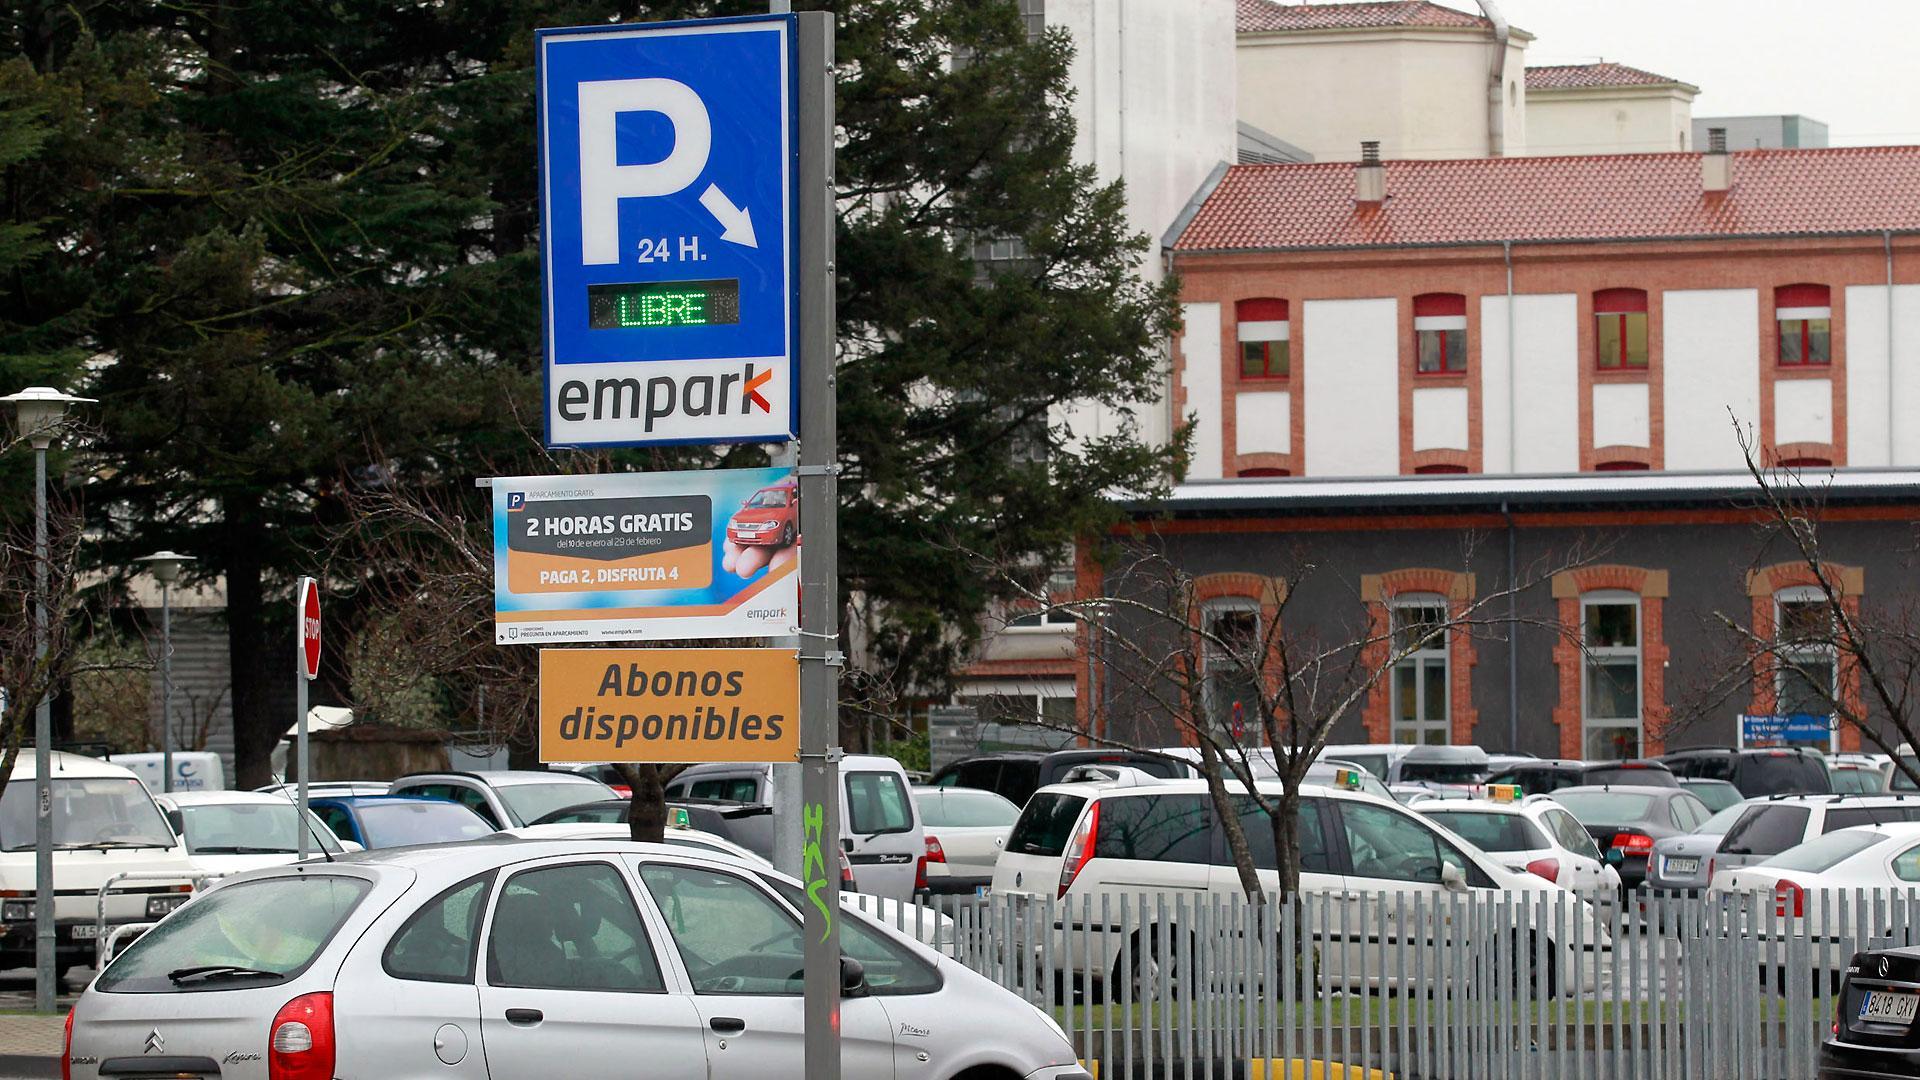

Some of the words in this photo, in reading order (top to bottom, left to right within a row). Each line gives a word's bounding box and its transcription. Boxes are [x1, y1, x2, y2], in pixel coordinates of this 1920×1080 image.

[578, 77, 712, 266] P
[638, 238, 670, 264] 24
[679, 236, 707, 261] H.
[620, 293, 706, 327] LIBRE
[557, 363, 772, 432] empark
[511, 494, 521, 507] P
[528, 489, 573, 499] APARCAMIENTO
[574, 489, 595, 497] GRATIS
[526, 518, 539, 537] 2
[544, 515, 615, 536] HORAS
[620, 512, 693, 534] GRATIS
[557, 540, 568, 549] del
[568, 540, 575, 548] 10
[575, 539, 585, 548] de
[607, 538, 614, 546] al
[614, 538, 625, 547] 29
[626, 537, 636, 546] de
[637, 536, 662, 546] febrero
[540, 568, 578, 585] PAGA
[581, 567, 594, 585] 2,
[598, 566, 666, 583] DISFRUTA
[668, 566, 679, 581] 4
[747, 607, 787, 620] empark
[304, 616, 320, 640] STOP
[520, 630, 545, 638] PREGUNTA
[553, 629, 589, 637] APARCAMIENTO
[601, 627, 643, 636] www.empark.com
[597, 663, 744, 697] Abonos
[559, 706, 784, 748] disponibles
[879, 854, 909, 863] Berlingo
[1868, 994, 1893, 1015] 8418
[1896, 996, 1917, 1017] GXV
